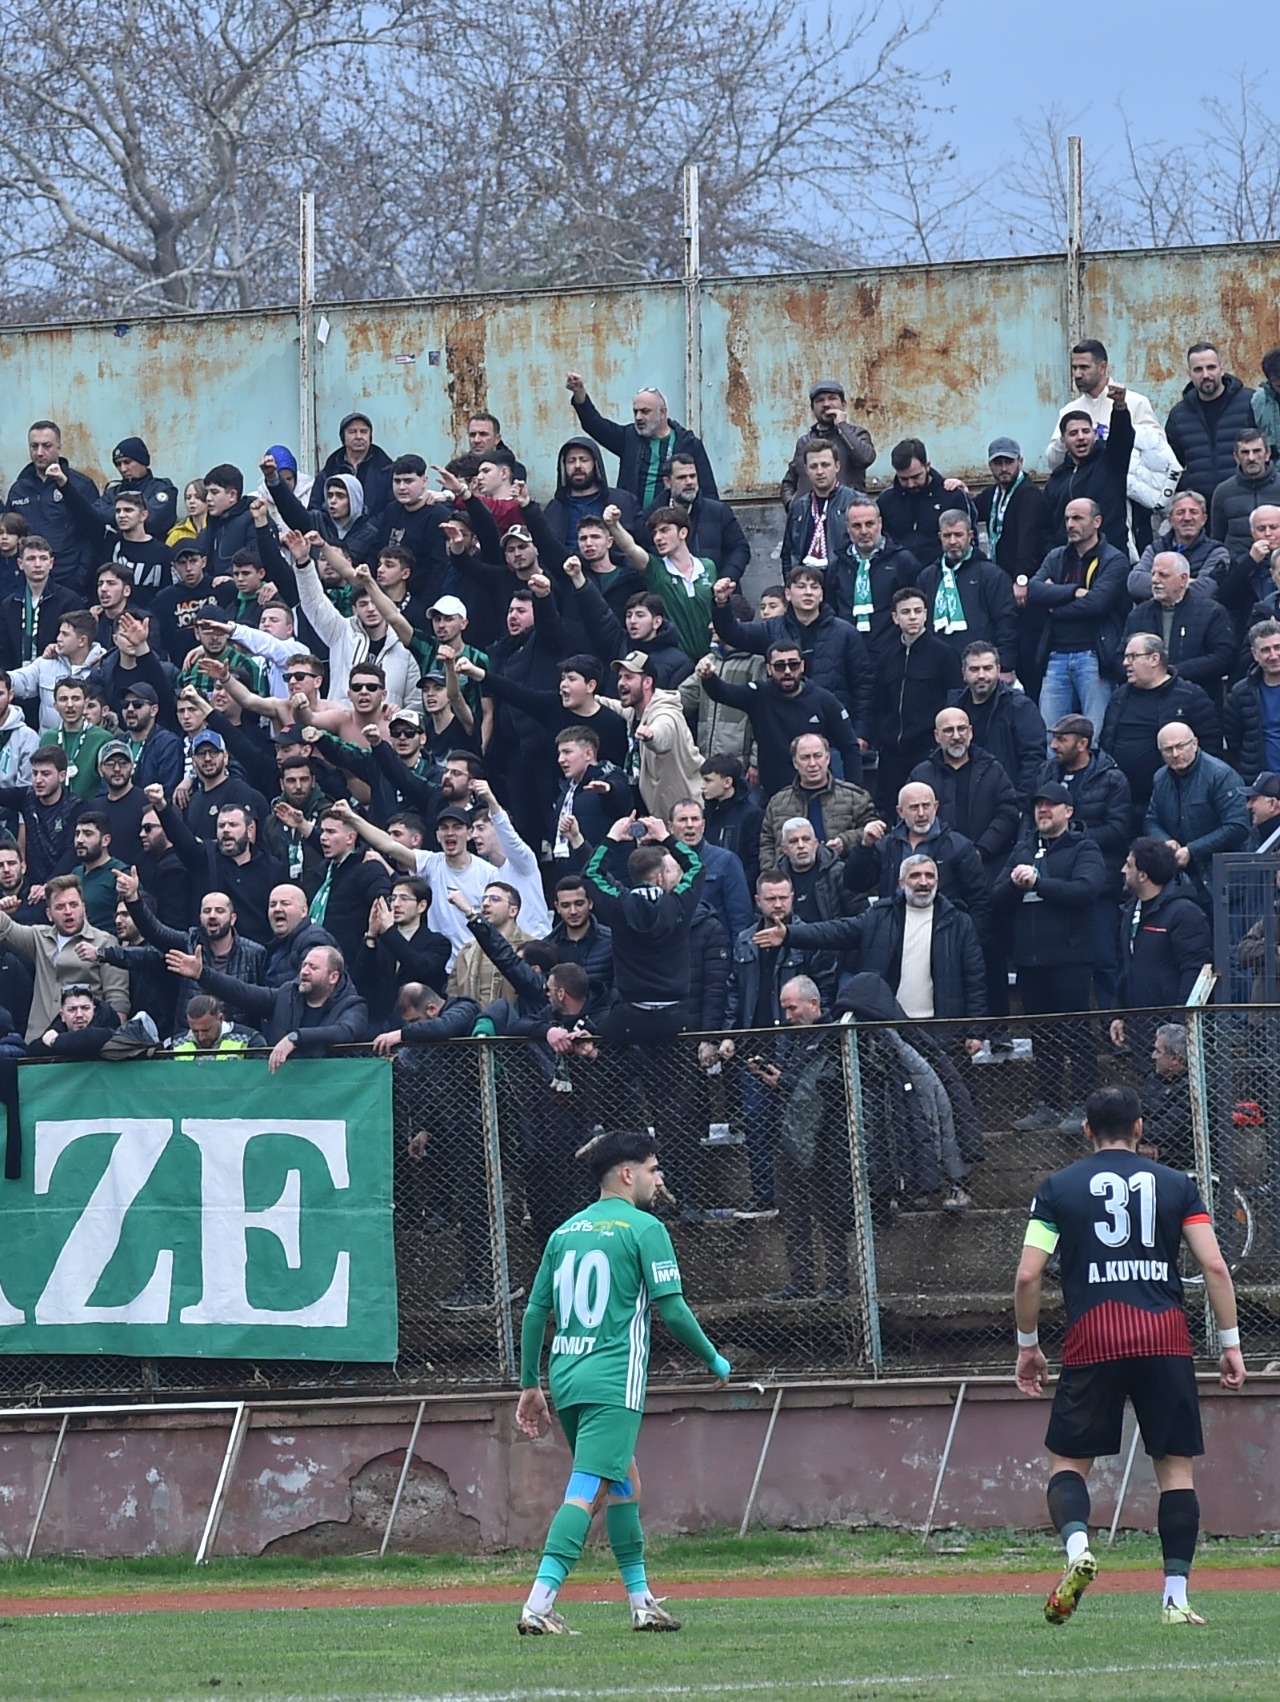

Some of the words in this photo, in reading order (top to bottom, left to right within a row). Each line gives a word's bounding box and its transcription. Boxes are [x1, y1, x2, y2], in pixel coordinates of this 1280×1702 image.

[1089, 1171, 1157, 1248] 31
[553, 1249, 611, 1329] 10
[552, 1335, 596, 1355] UMUT
